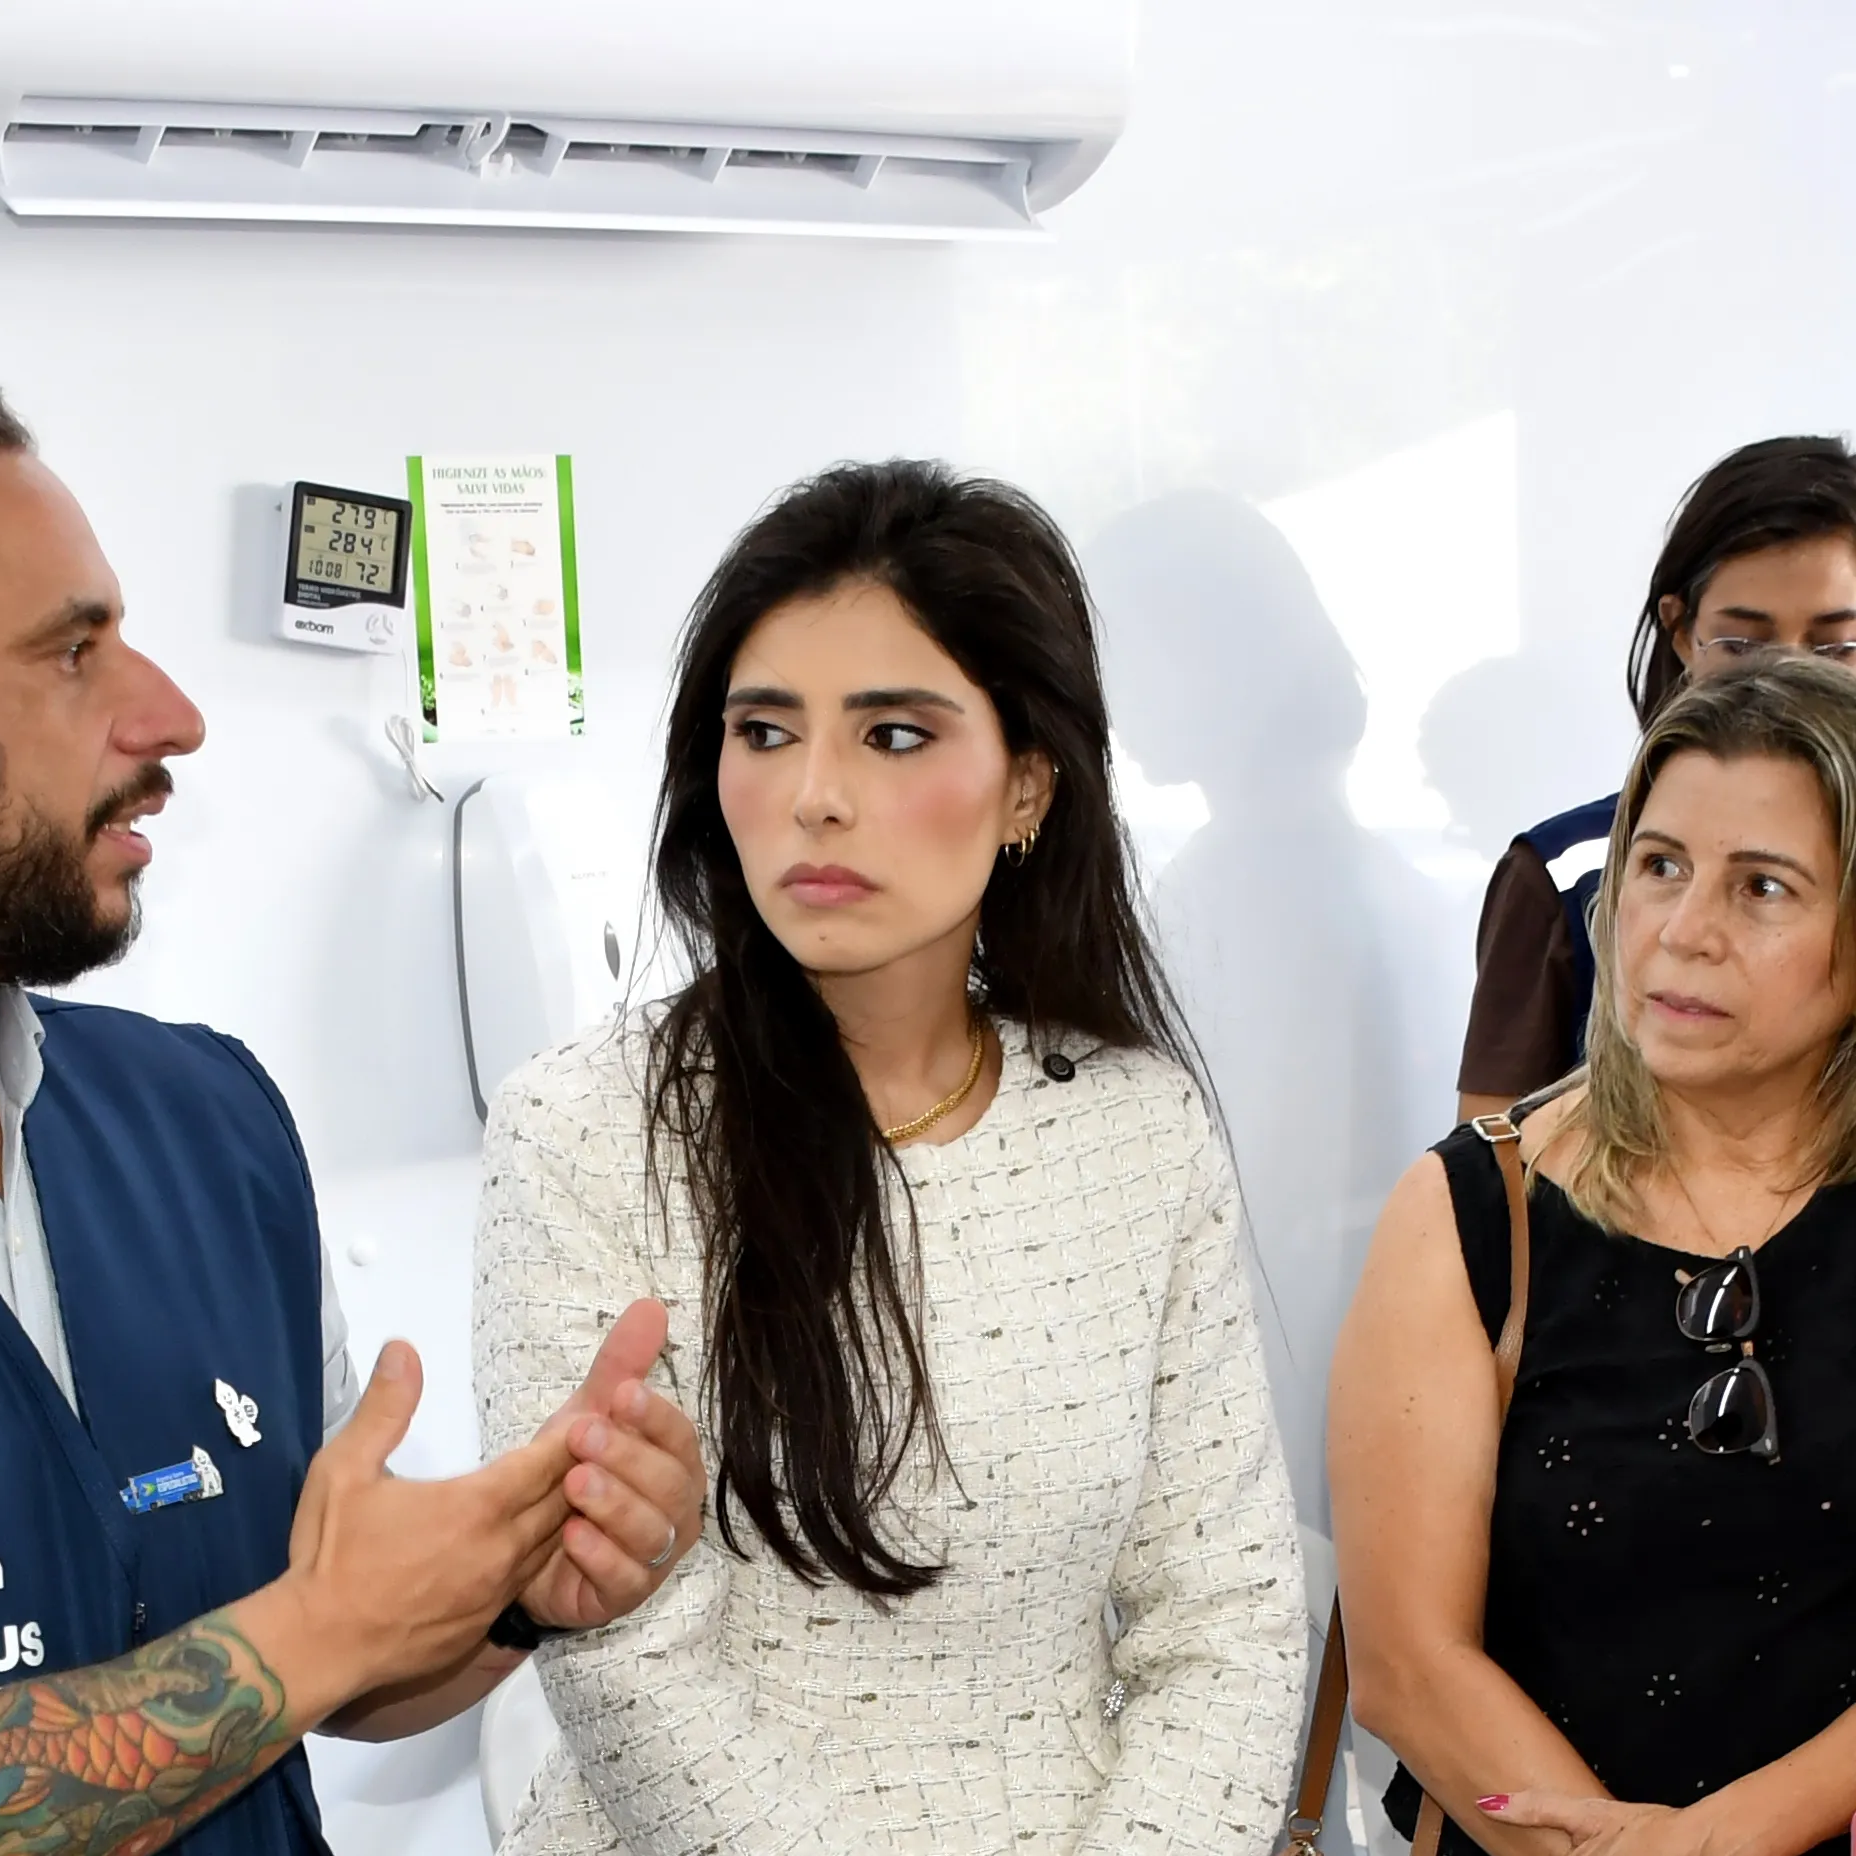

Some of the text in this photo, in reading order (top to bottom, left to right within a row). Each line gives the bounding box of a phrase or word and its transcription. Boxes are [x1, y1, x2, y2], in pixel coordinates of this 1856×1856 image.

[432, 467, 487, 480] HIGIENIZE
[493, 467, 506, 479] AS
[457, 482, 525, 495] SALVE VIDAS
